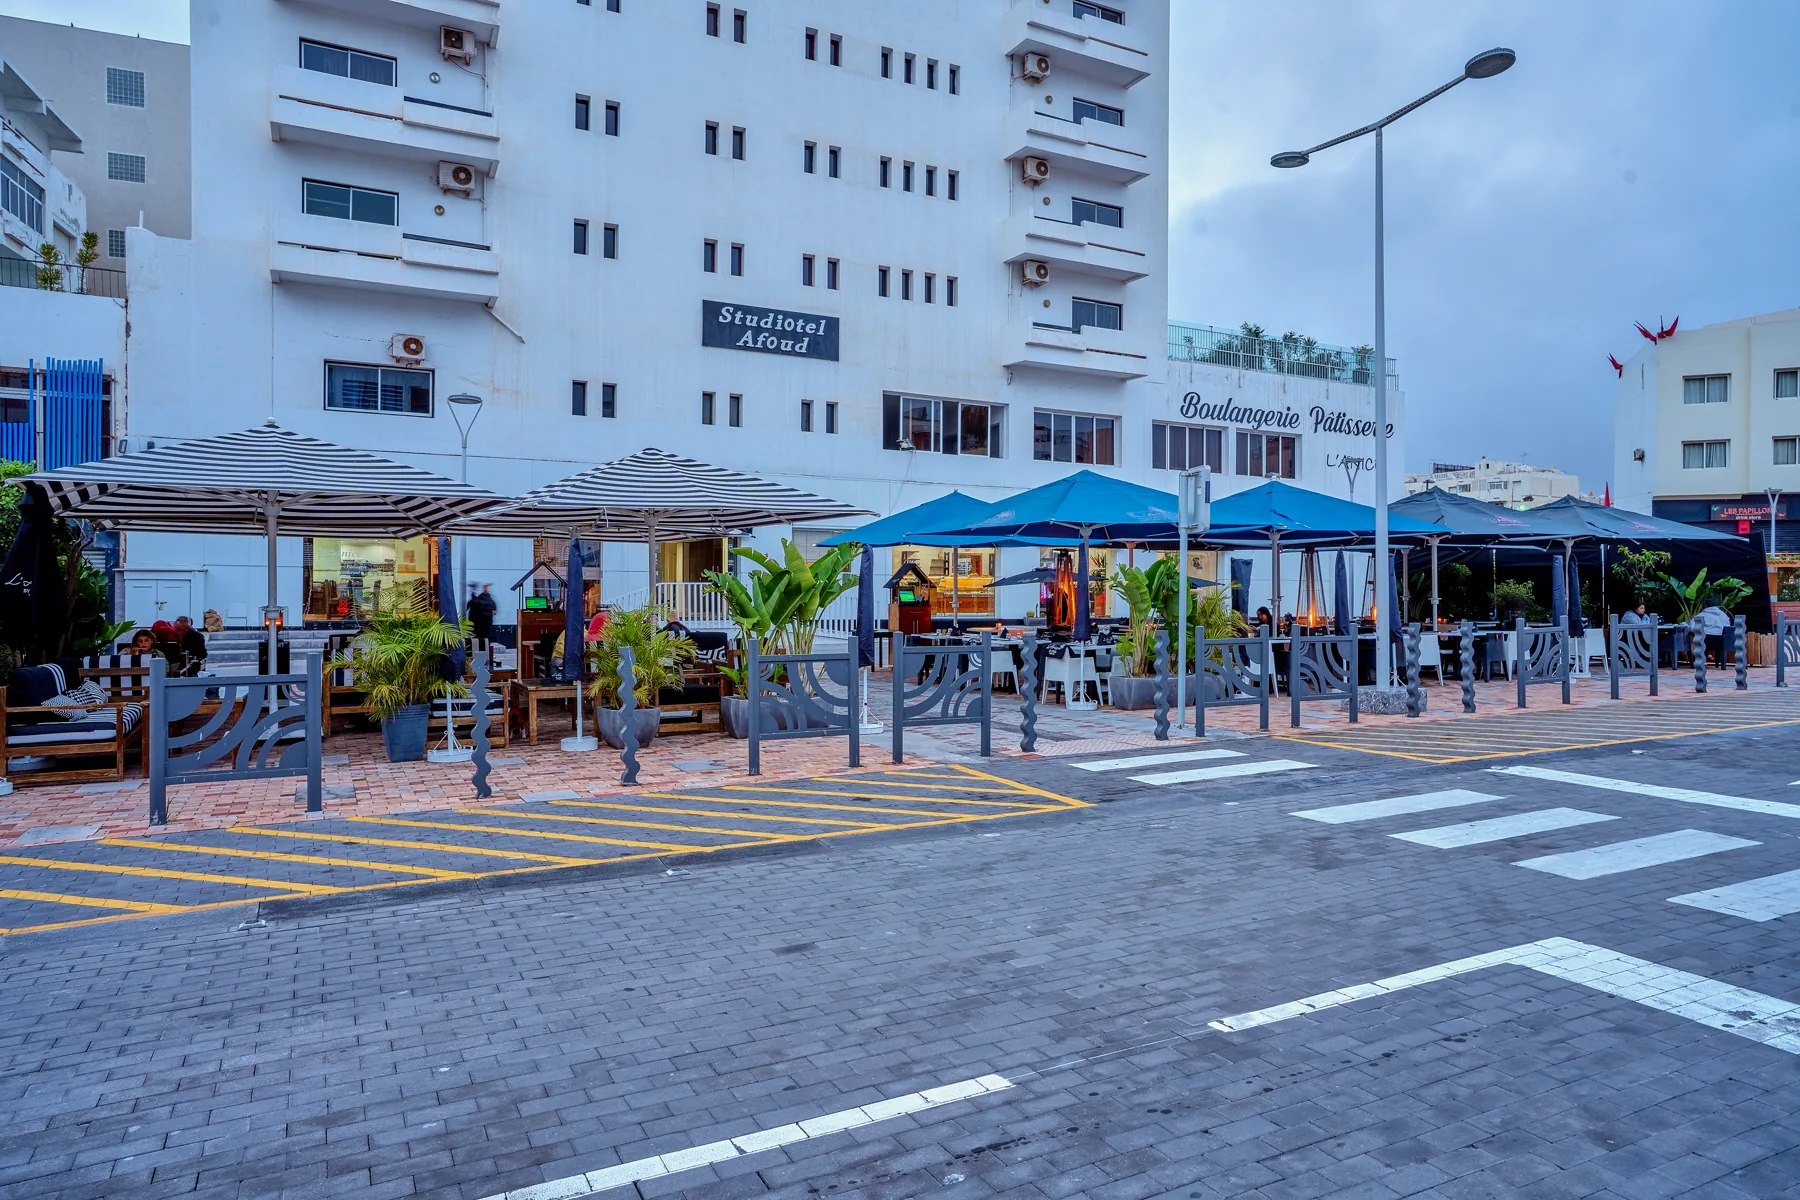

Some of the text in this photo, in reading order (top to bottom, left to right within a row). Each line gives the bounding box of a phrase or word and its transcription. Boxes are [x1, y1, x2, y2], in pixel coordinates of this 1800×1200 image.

[718, 306, 826, 336] Studiotel
[736, 330, 810, 353] Afoud
[1179, 391, 1395, 439] Boulangerie Pâtissere
